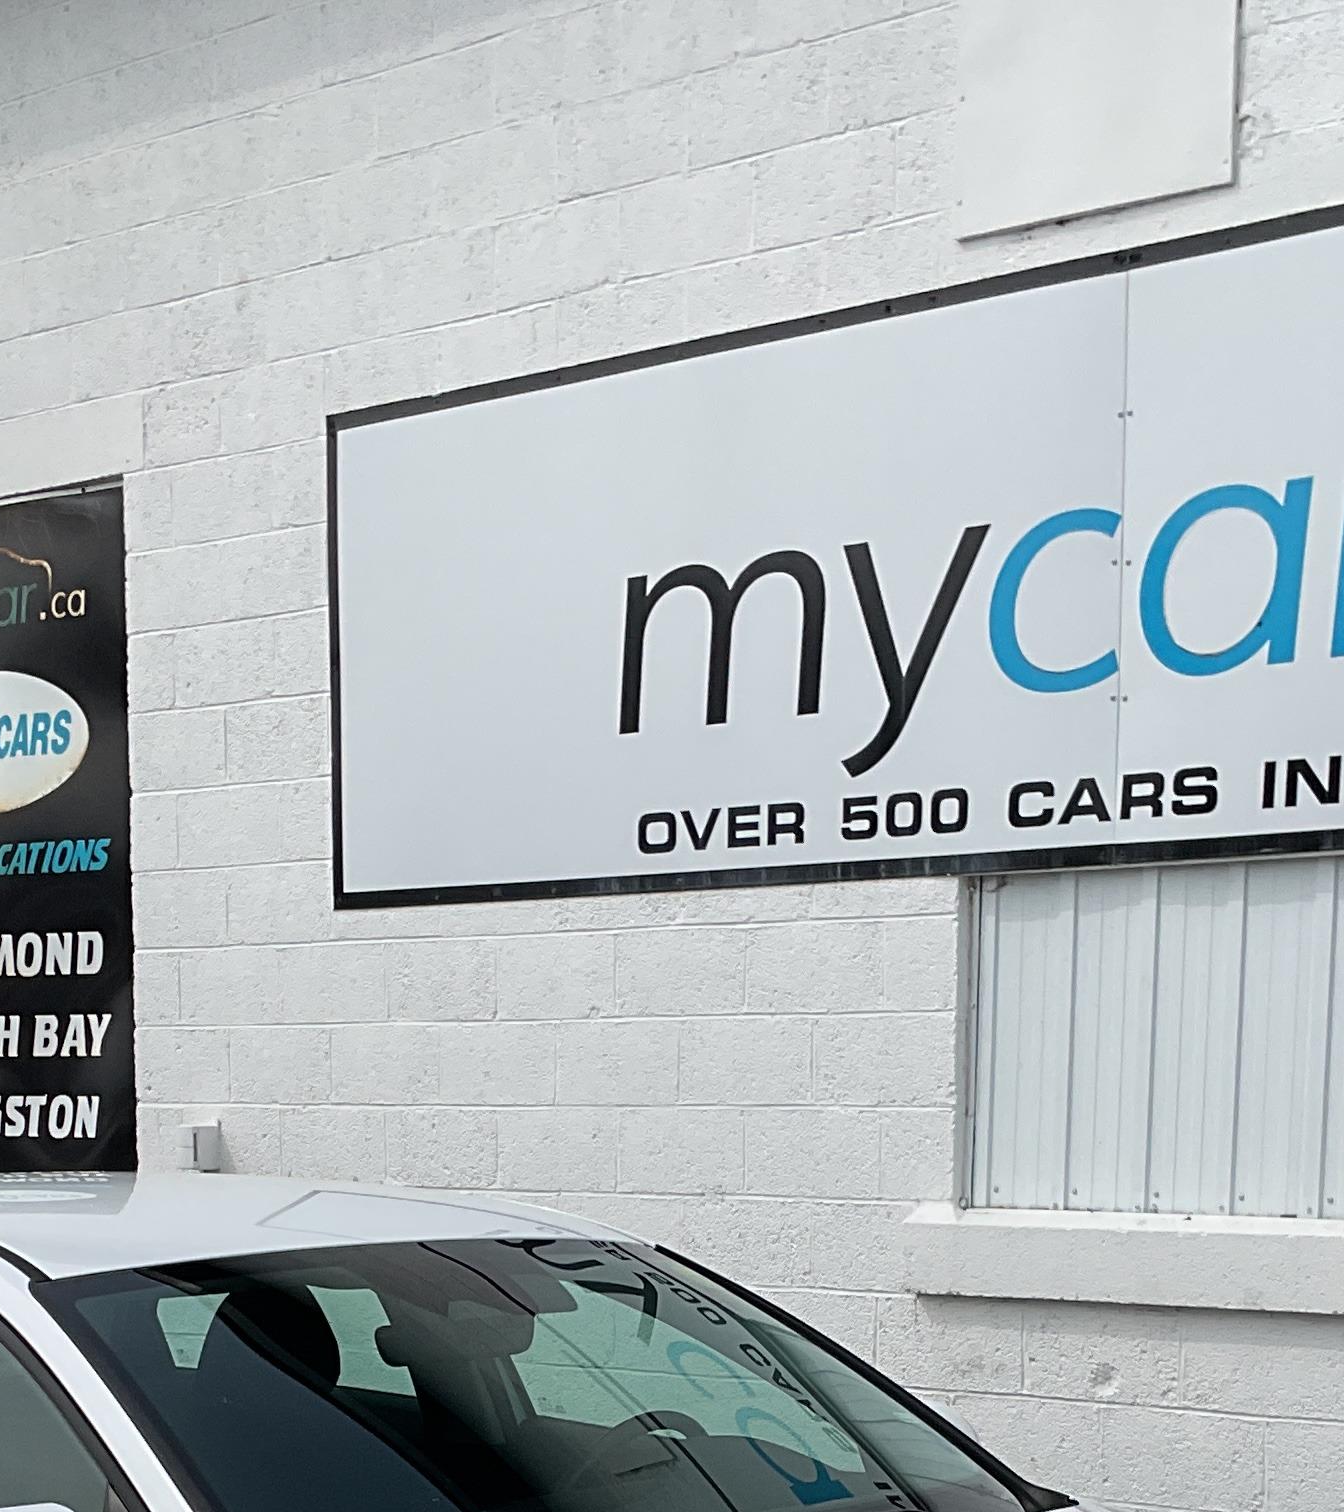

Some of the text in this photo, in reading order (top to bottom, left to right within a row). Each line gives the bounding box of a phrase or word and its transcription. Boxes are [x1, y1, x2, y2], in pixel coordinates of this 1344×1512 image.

[637, 803, 805, 855] OVER
[841, 789, 969, 841] 500
[1008, 767, 1218, 828] CARS
[1262, 756, 1342, 809] IN
[32, 1013, 113, 1058] BAY
